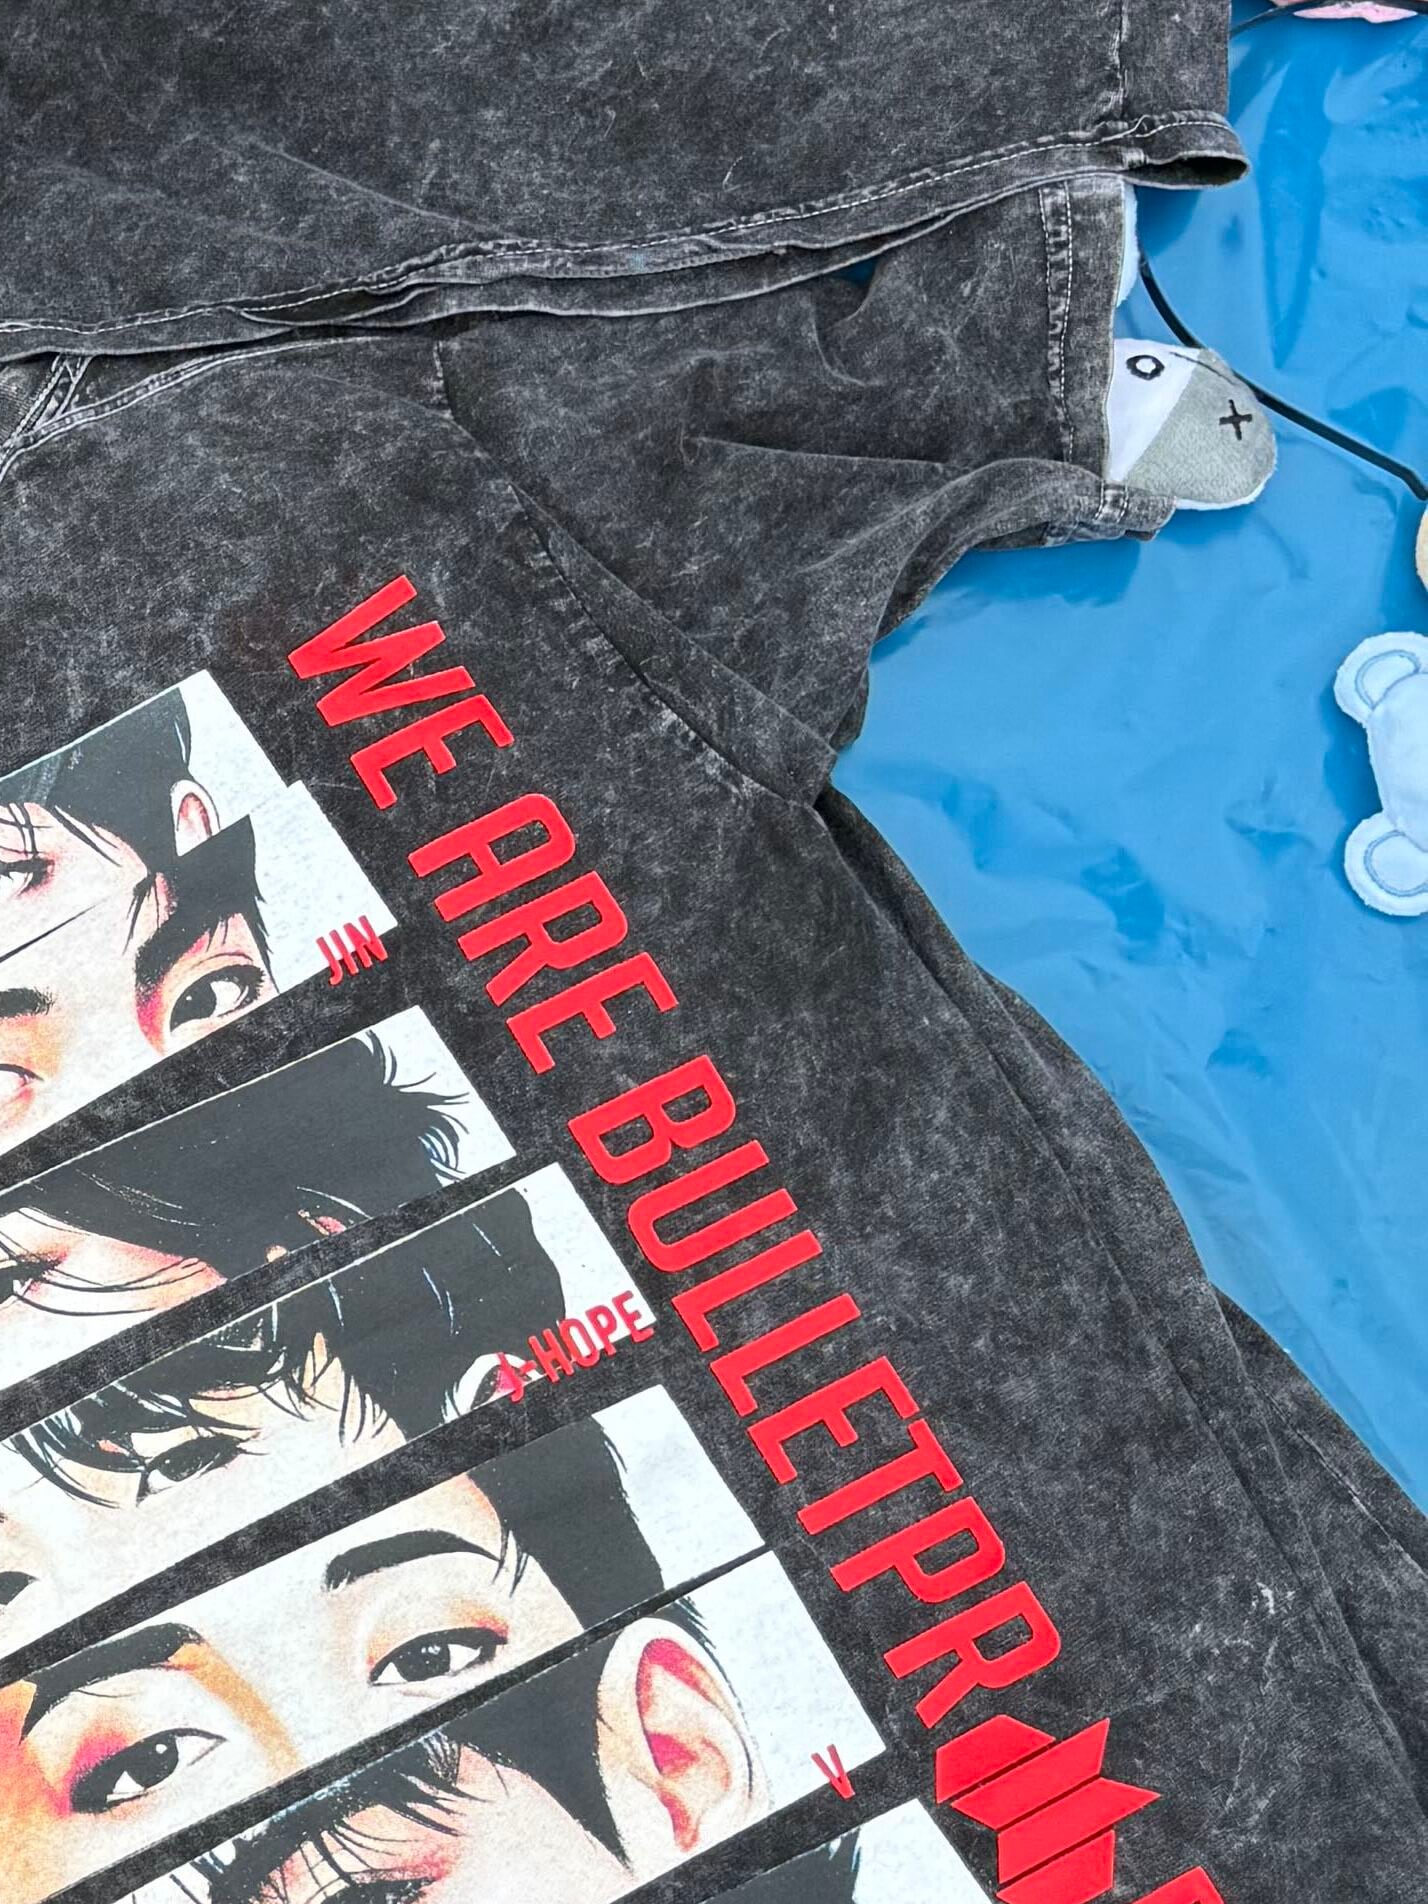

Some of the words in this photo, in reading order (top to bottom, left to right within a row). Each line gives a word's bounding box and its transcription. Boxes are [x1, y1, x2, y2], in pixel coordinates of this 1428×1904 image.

[286, 574, 515, 811] WE
[407, 792, 679, 1076] ARE
[315, 914, 389, 986] JIN
[495, 1289, 655, 1403] J-HOPE
[810, 1743, 856, 1800] V
